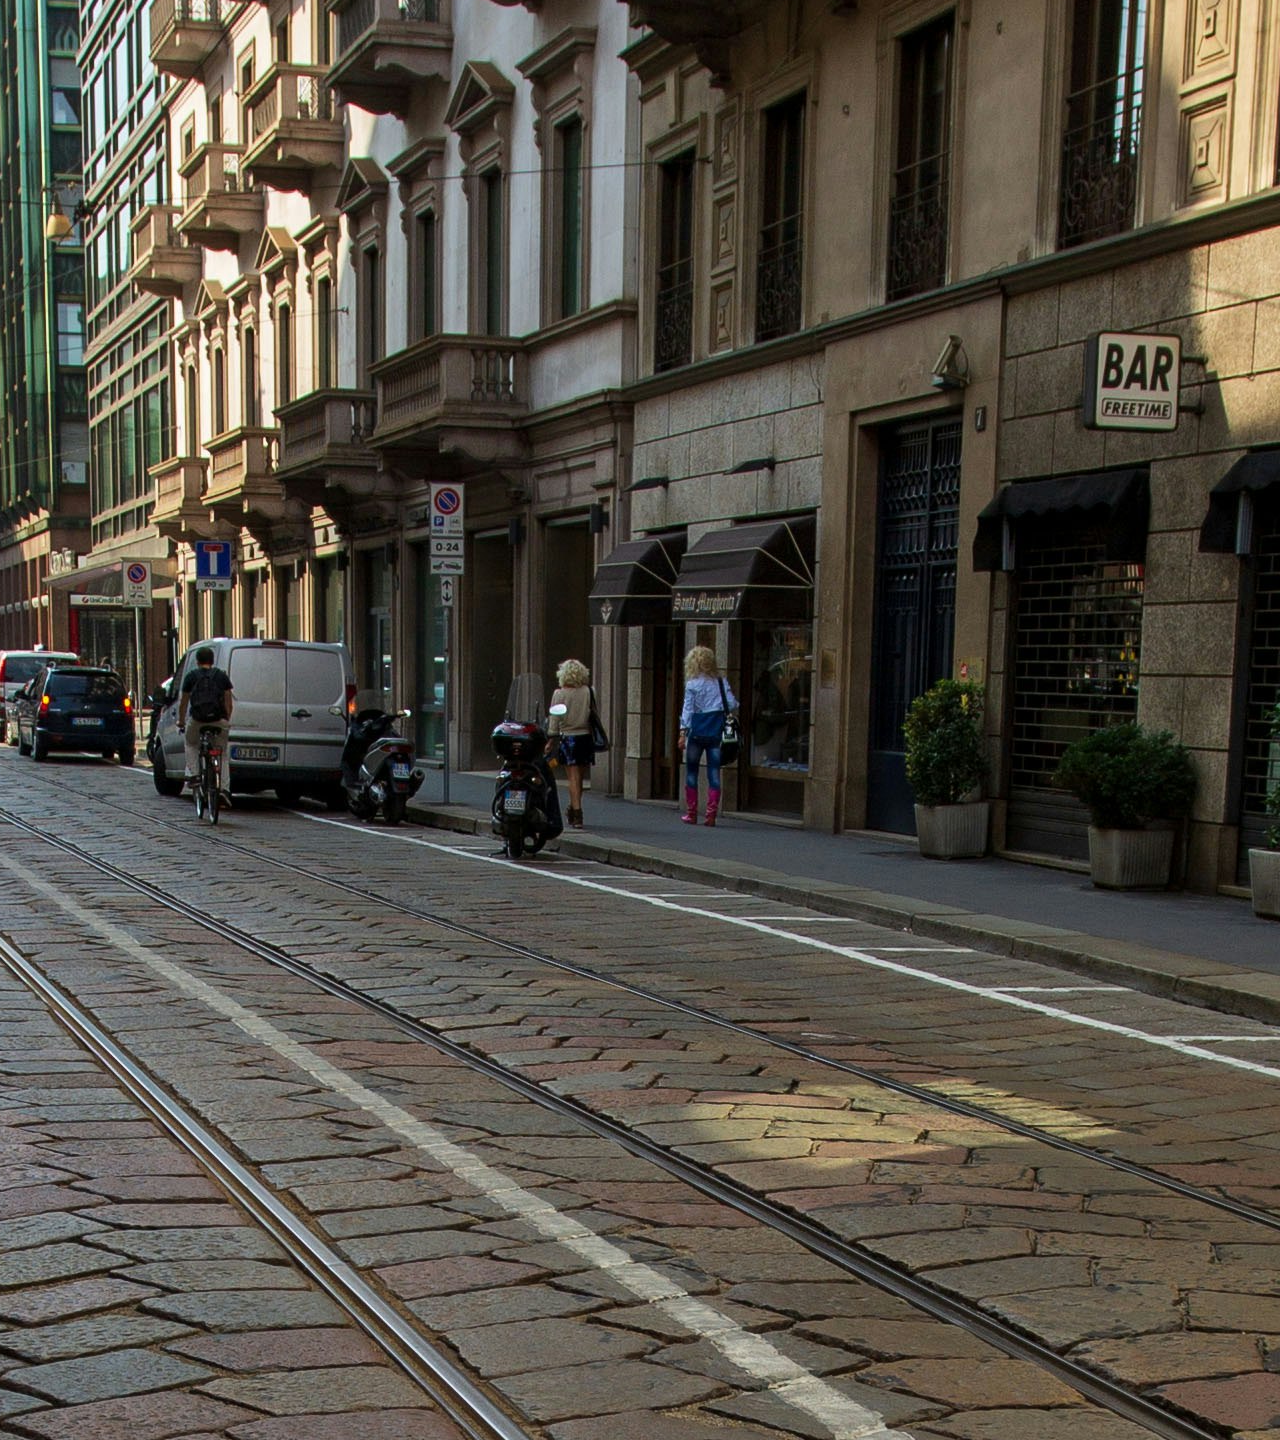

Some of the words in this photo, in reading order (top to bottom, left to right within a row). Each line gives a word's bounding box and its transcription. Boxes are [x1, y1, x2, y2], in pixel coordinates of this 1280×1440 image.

[1101, 343, 1174, 392] BAR
[1104, 401, 1170, 417] FREETIME
[435, 542, 459, 552] 0-24
